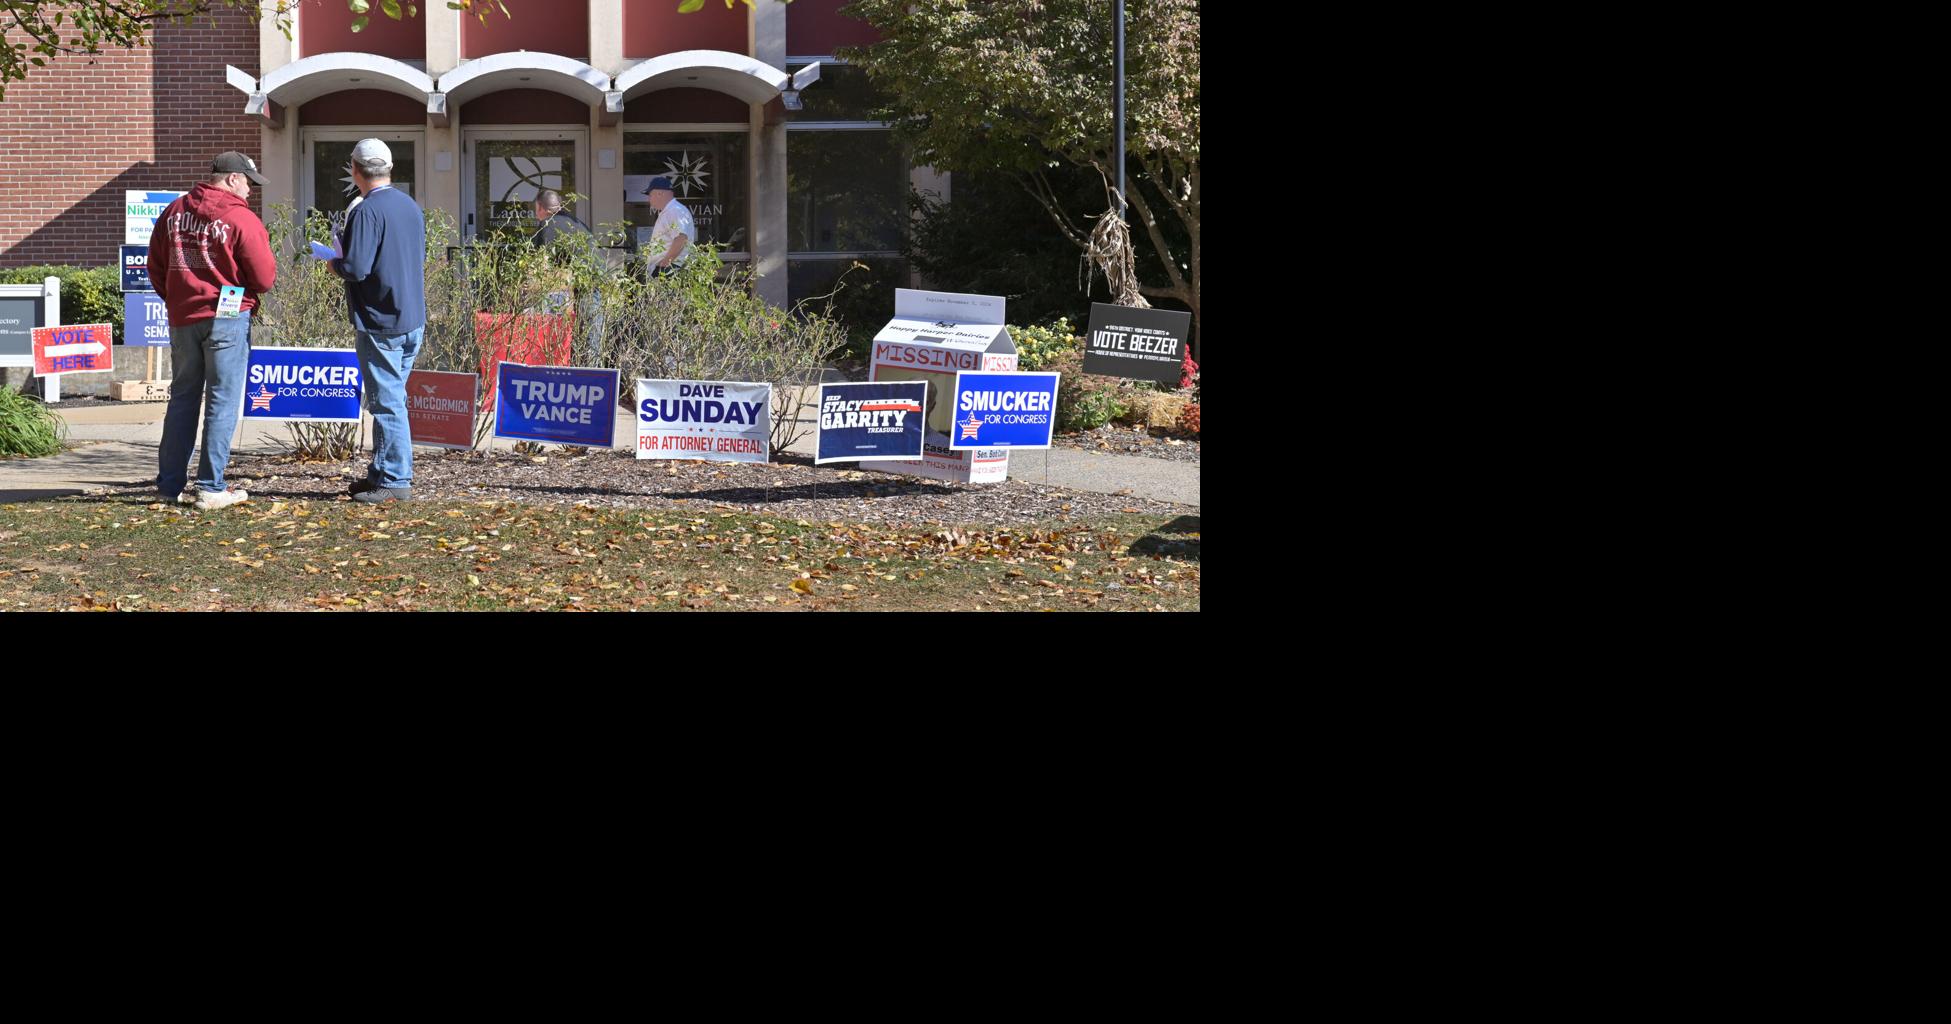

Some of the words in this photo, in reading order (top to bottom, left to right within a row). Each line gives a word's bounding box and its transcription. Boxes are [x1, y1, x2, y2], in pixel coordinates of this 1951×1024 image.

[52, 330, 95, 345] VOTE
[144, 326, 170, 338] SENA
[889, 325, 918, 333] Happy
[920, 328, 954, 336] Harper
[954, 331, 990, 340] Dairies
[1093, 330, 1128, 350] VOTE
[1130, 334, 1178, 356] BEEZER
[53, 356, 96, 370] HERE
[876, 343, 979, 370] MISSING!
[250, 364, 358, 386] SMUCKER
[278, 387, 297, 398] FOR
[300, 388, 356, 398] CONGRESS
[511, 379, 604, 406] TRUMP
[680, 384, 724, 398] DAVE
[822, 400, 864, 413] STACY
[960, 390, 1051, 412] SMUCKER
[522, 403, 592, 425] VANCE
[640, 398, 763, 425] SUNDAY
[821, 410, 907, 430] GARRITY
[984, 414, 1000, 424] FOR
[1002, 414, 1047, 424] CONGRESS
[640, 435, 658, 450] FOR
[662, 436, 714, 452] ATTORNEY
[716, 438, 762, 454] GENERAL
[926, 460, 946, 470] THIS
